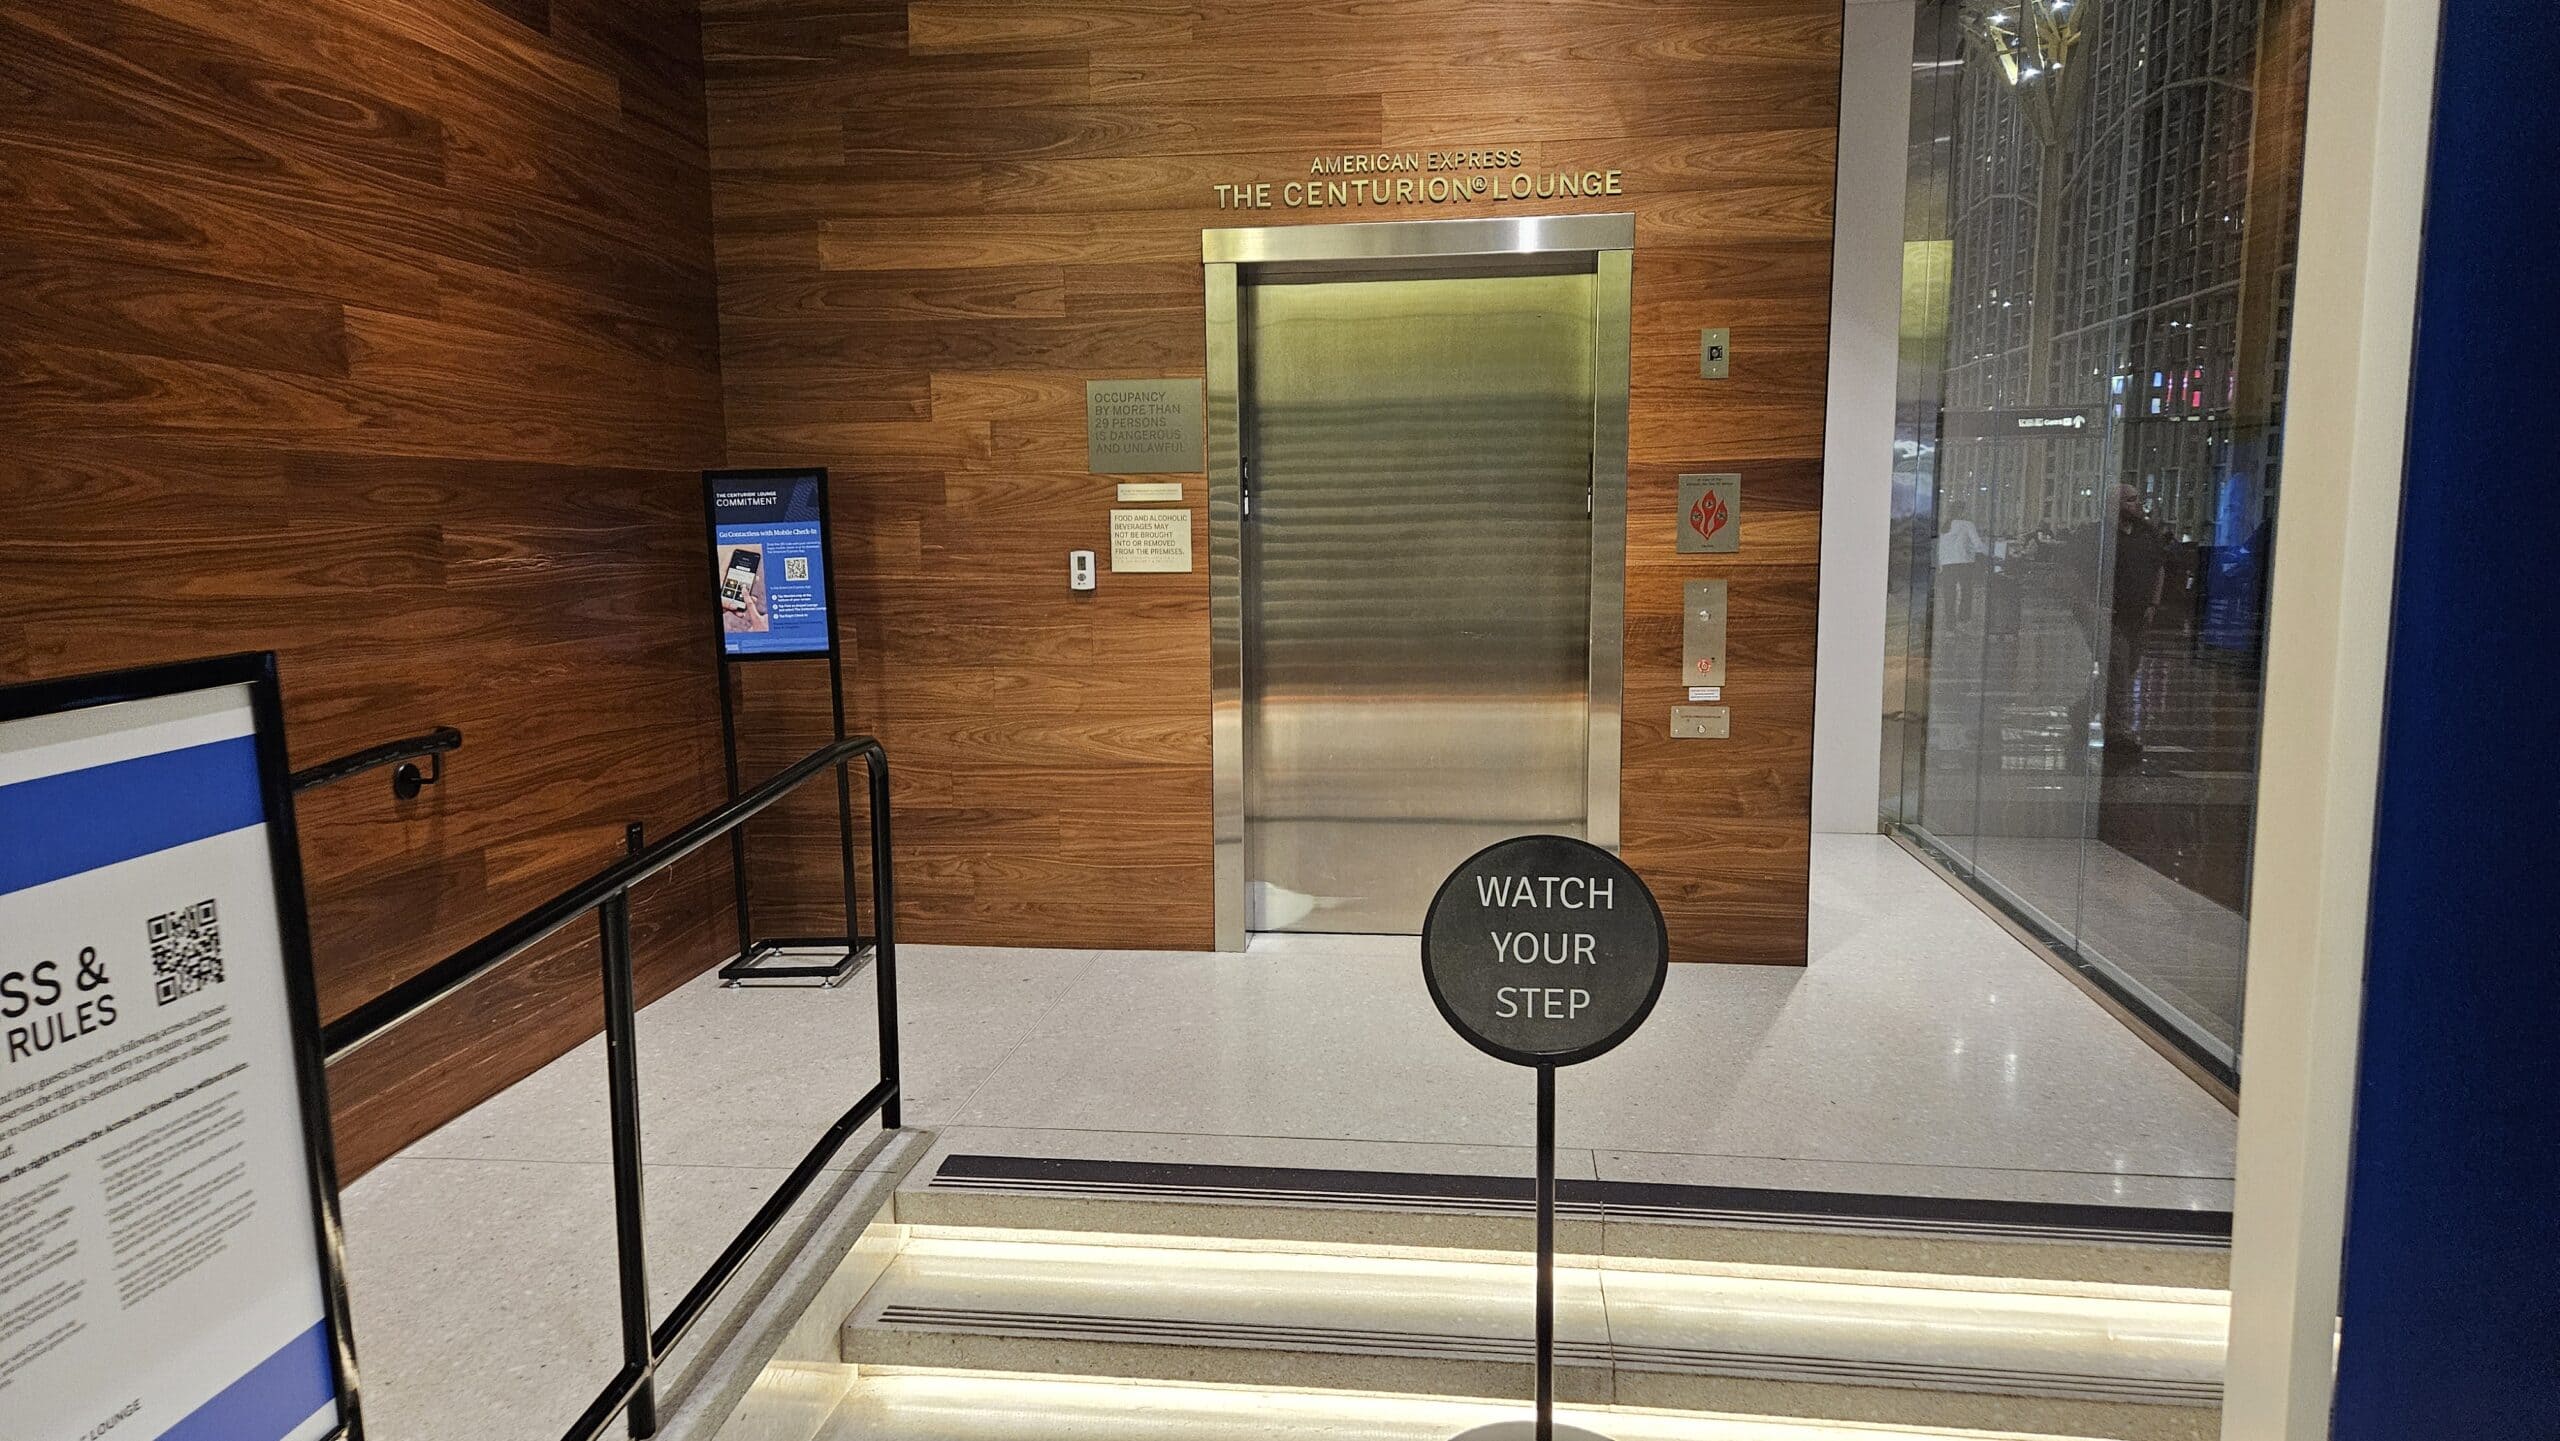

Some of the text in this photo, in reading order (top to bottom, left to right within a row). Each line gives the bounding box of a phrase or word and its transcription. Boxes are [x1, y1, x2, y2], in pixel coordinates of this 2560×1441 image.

[1310, 148, 1522, 176] AMERICAN EXPRESS
[1213, 183, 1272, 210] THE
[1493, 169, 1623, 201] LOUNGE
[1094, 391, 1166, 403] OCCUPANCY
[1095, 404, 1181, 416] BY MORE THAN
[1095, 417, 1167, 429] 29 PERSONS
[1095, 429, 1181, 441] IS DANGEROUS
[1096, 441, 1184, 454] AND UNLAWFUL
[716, 496, 777, 507] COMMITMENT
[1114, 514, 1133, 522] FOOD
[1476, 875, 1615, 910] WATCH
[1490, 931, 1597, 965] YOUR
[77, 946, 109, 992] &
[1495, 986, 1591, 1020] STEP
[7, 994, 118, 1063] RULES
[90, 1398, 142, 1441] LOUNGE
